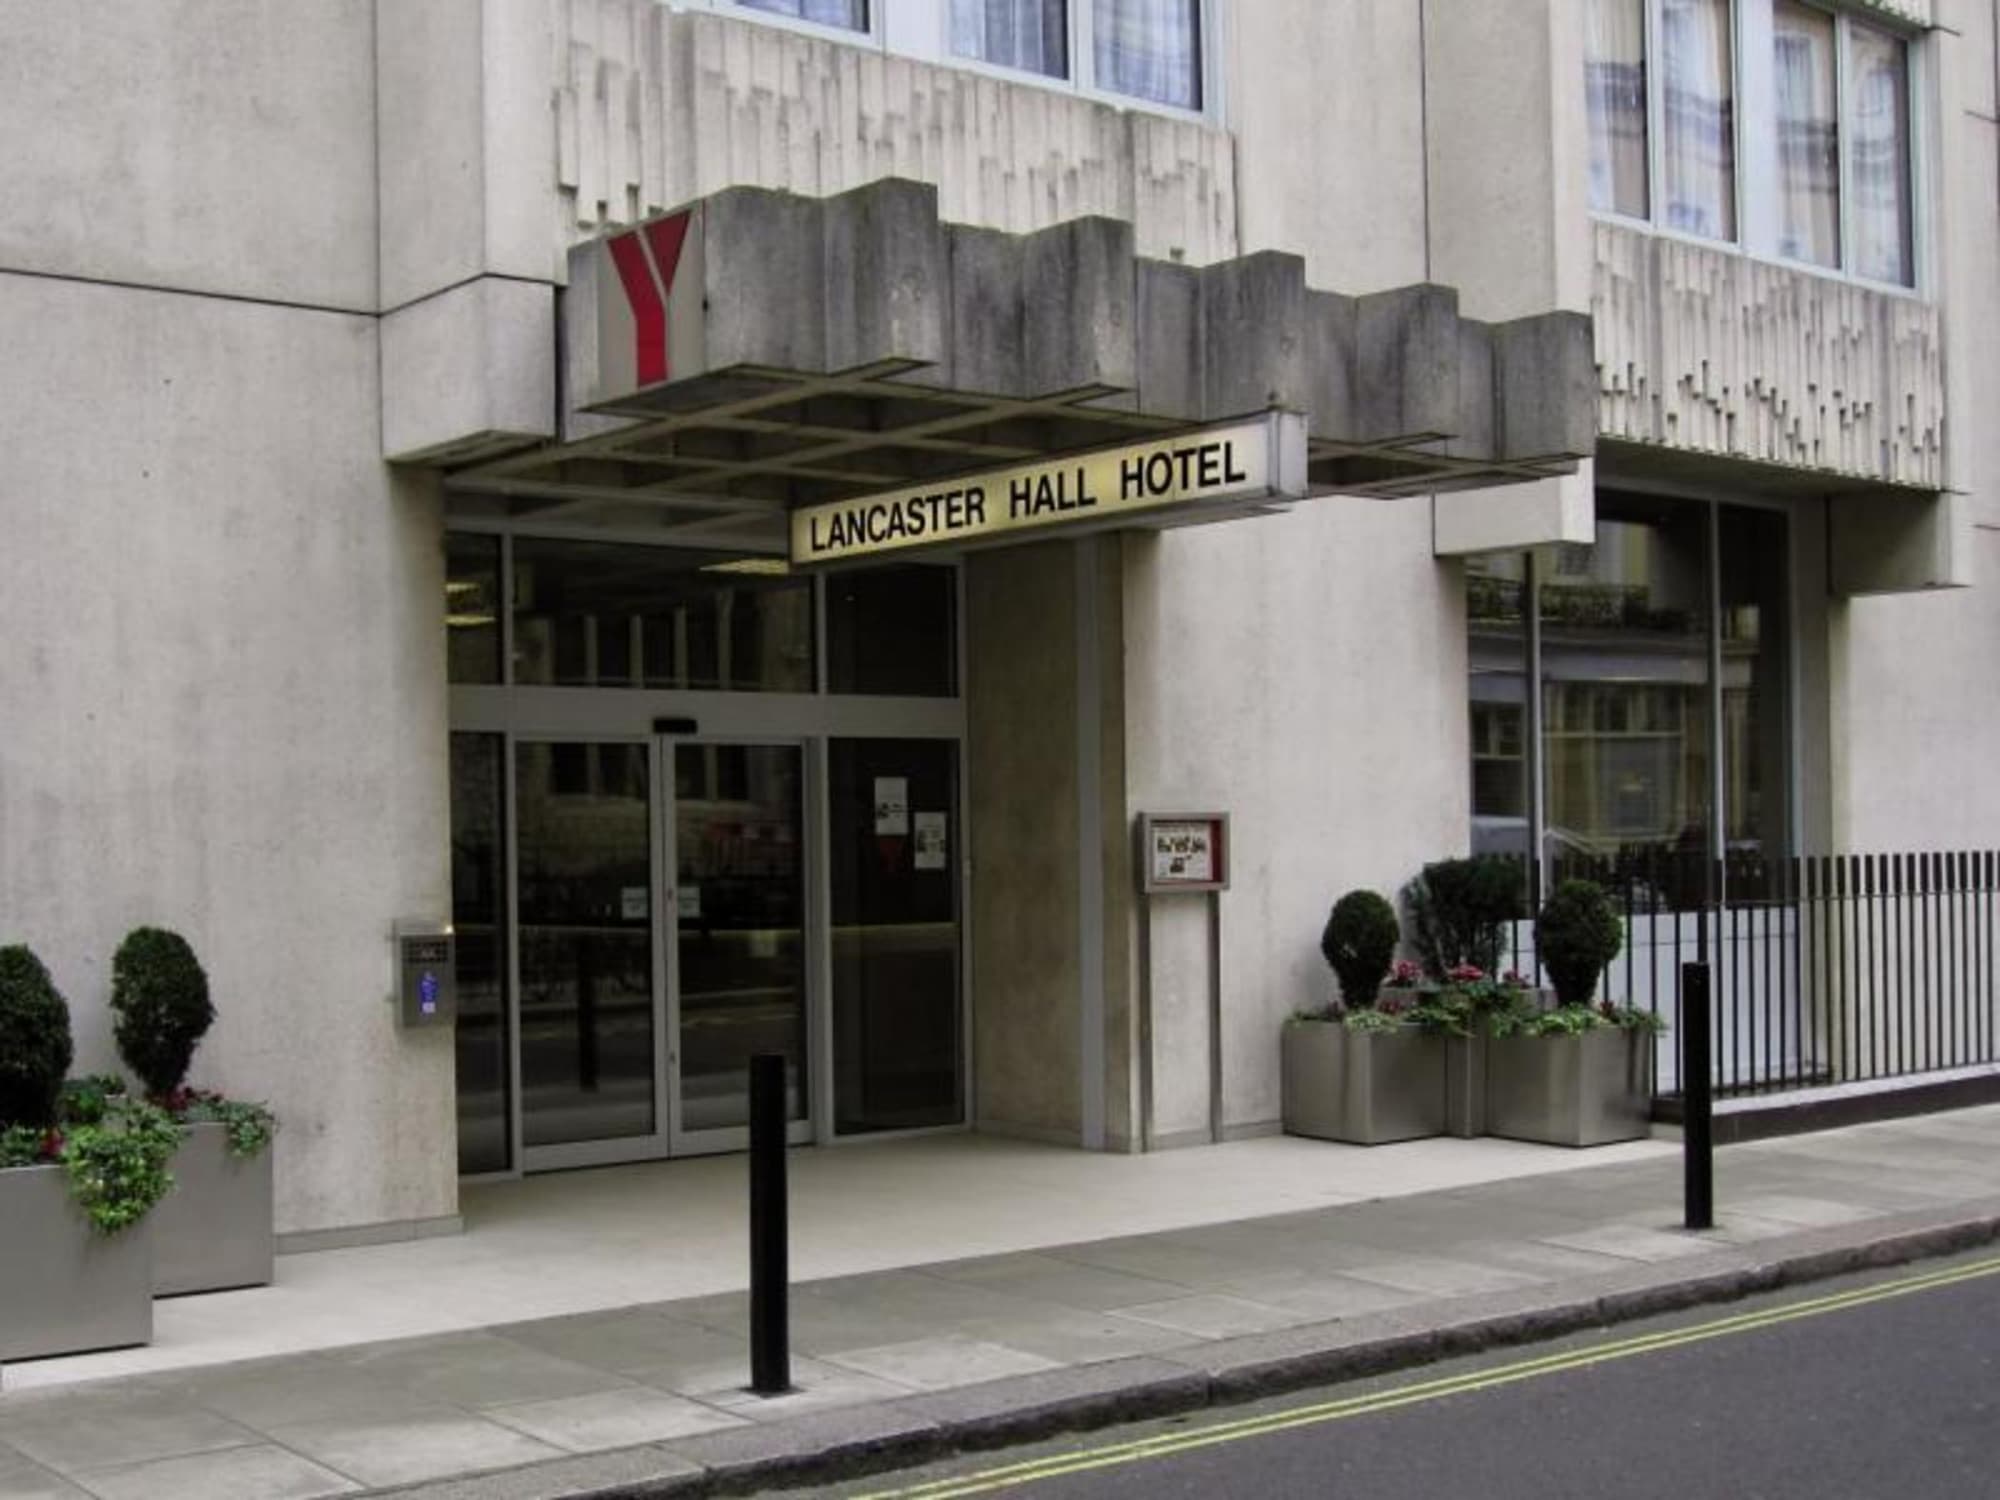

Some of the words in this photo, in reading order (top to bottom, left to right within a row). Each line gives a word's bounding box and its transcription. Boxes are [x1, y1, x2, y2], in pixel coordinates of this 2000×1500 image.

[811, 486, 985, 552] LANCASTER
[1009, 467, 1097, 519] HALL
[1120, 440, 1246, 501] HOTEL
